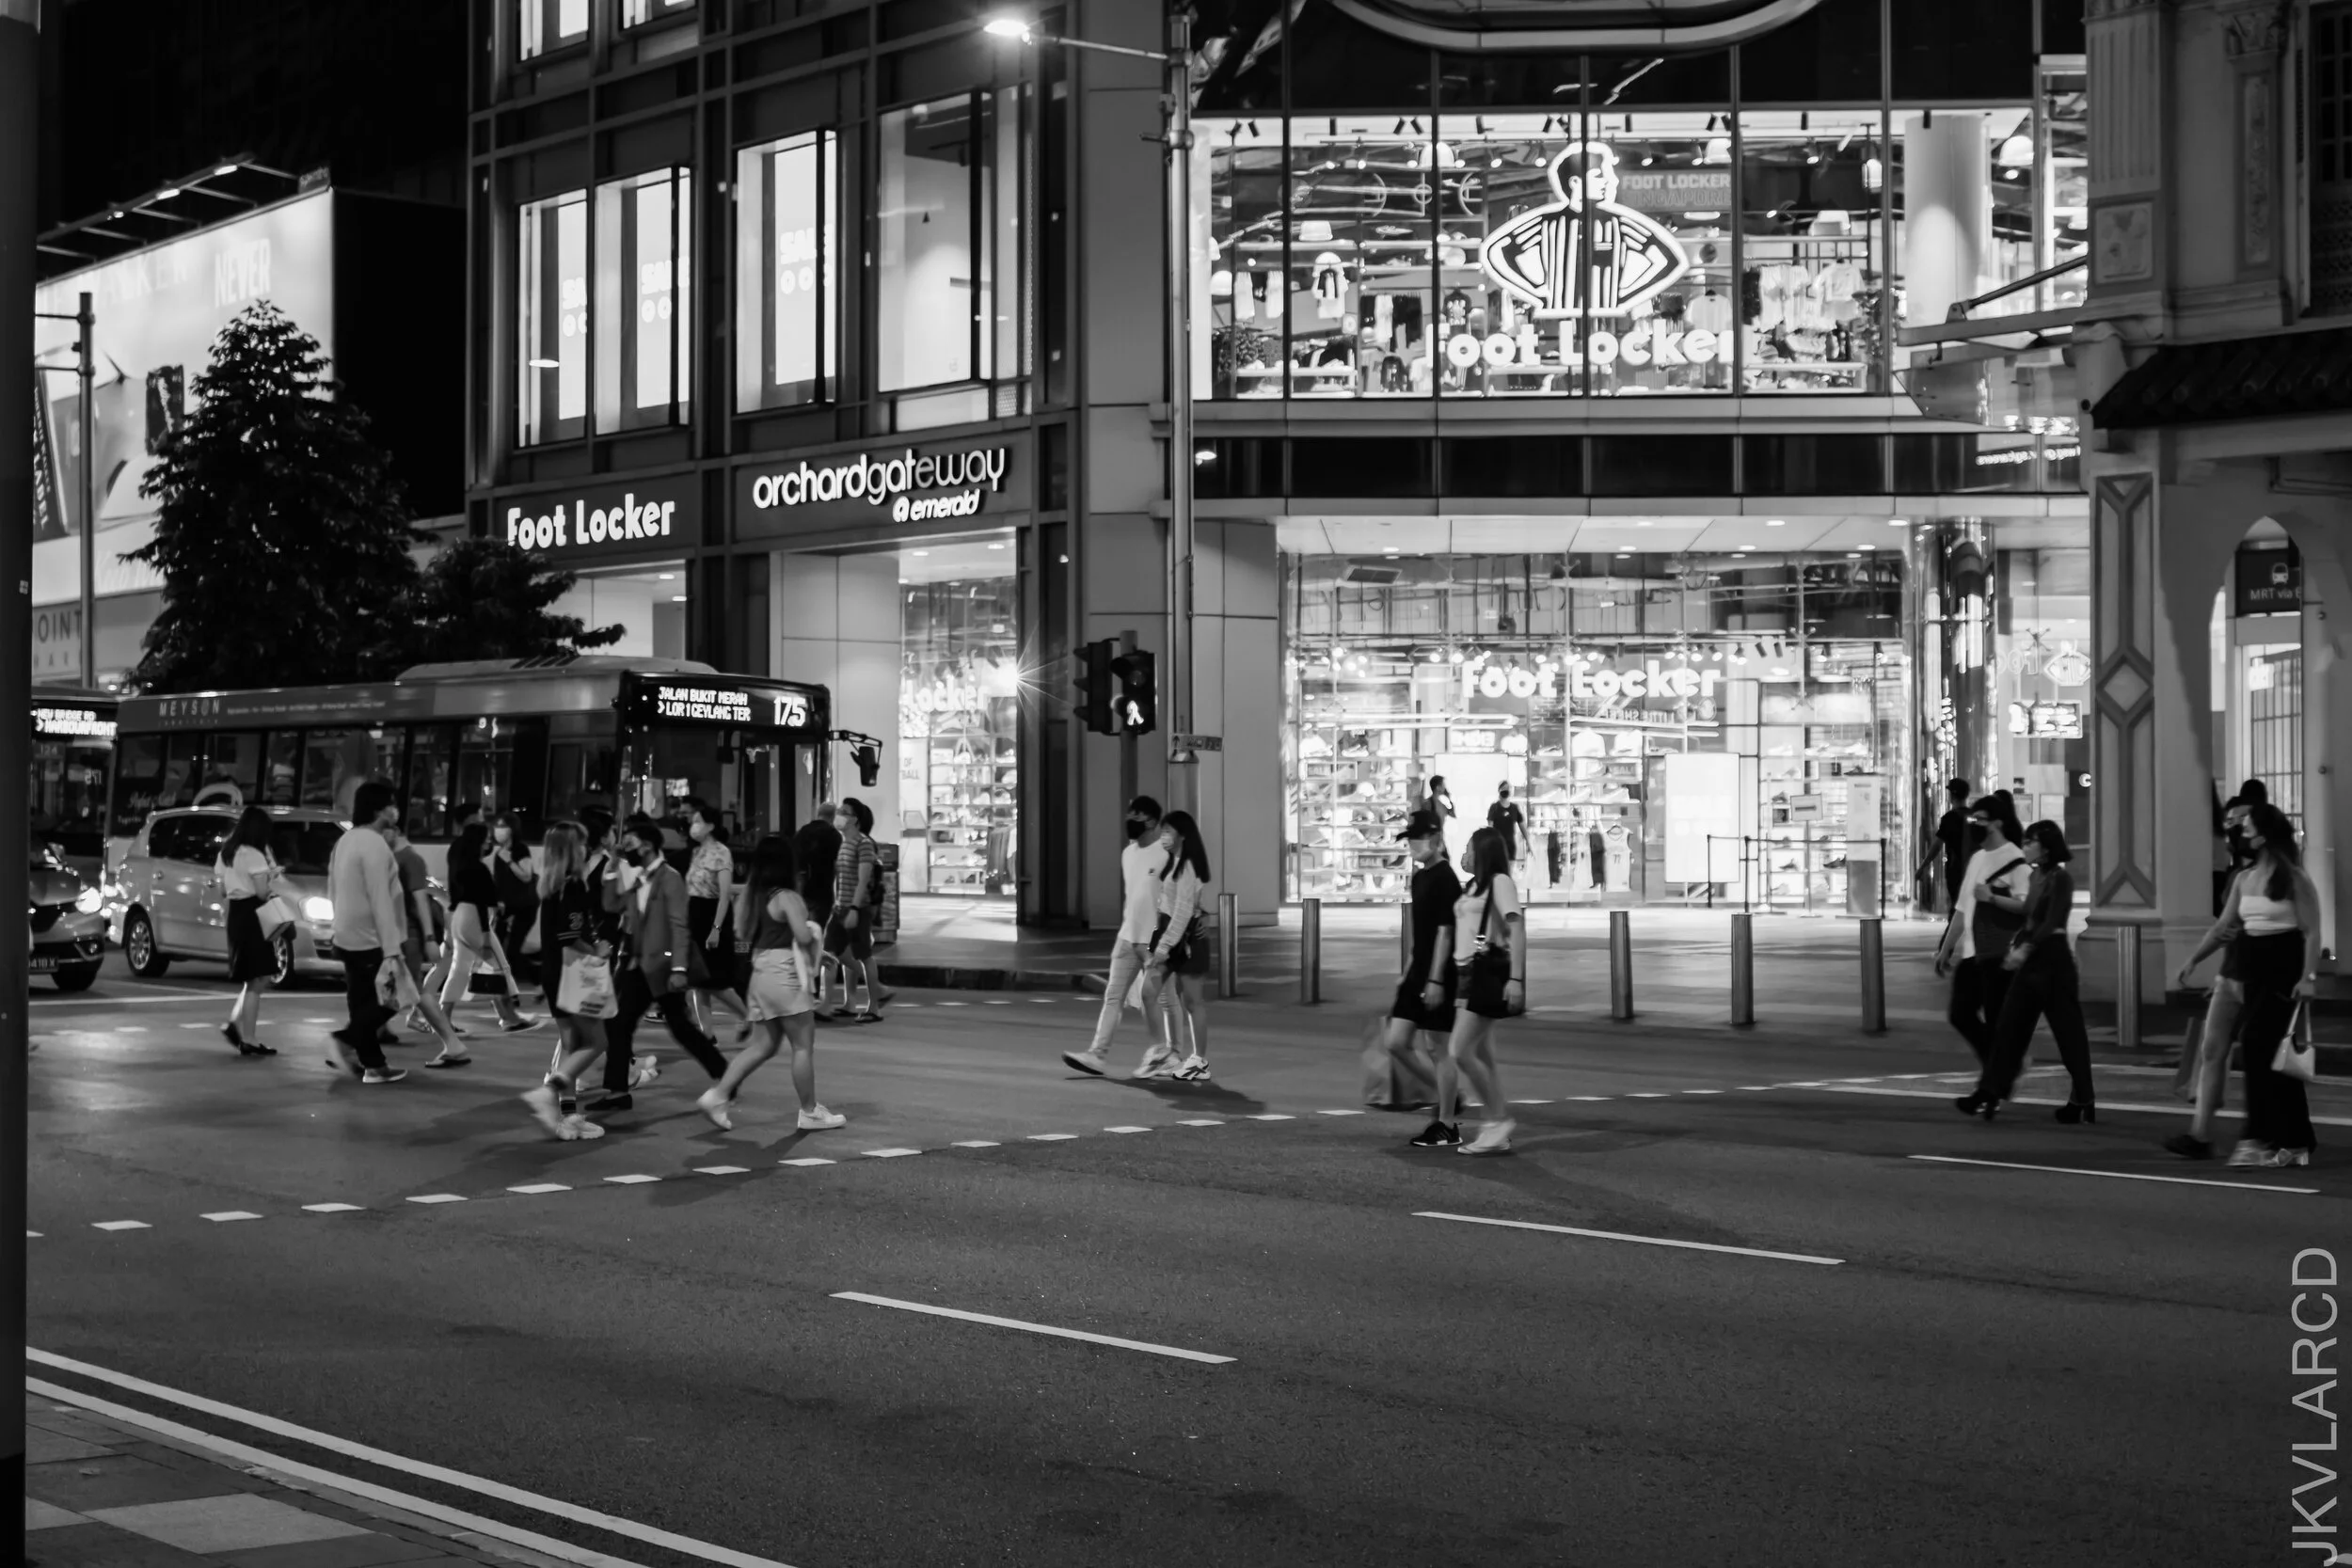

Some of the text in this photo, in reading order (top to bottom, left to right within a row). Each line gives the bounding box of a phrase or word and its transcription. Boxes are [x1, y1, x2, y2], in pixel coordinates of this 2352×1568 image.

[1622, 173, 1732, 190] FOOT LOCKER
[215, 238, 271, 309] NEVER
[1425, 319, 1735, 368] Foot Locker
[754, 448, 1005, 508] orchardgateway
[910, 487, 980, 520] emerald
[507, 493, 675, 550] Foot Locker
[2249, 588, 2275, 600] MRT
[2278, 589, 2293, 599] via
[905, 673, 990, 712] Locker
[1462, 657, 1721, 698] Foot Locker
[159, 706, 220, 718] MEYSON
[659, 686, 748, 705] JALAN BUKIT MERAH
[666, 701, 751, 721] LOR 1 GEYLANG TER
[773, 695, 806, 727] 175
